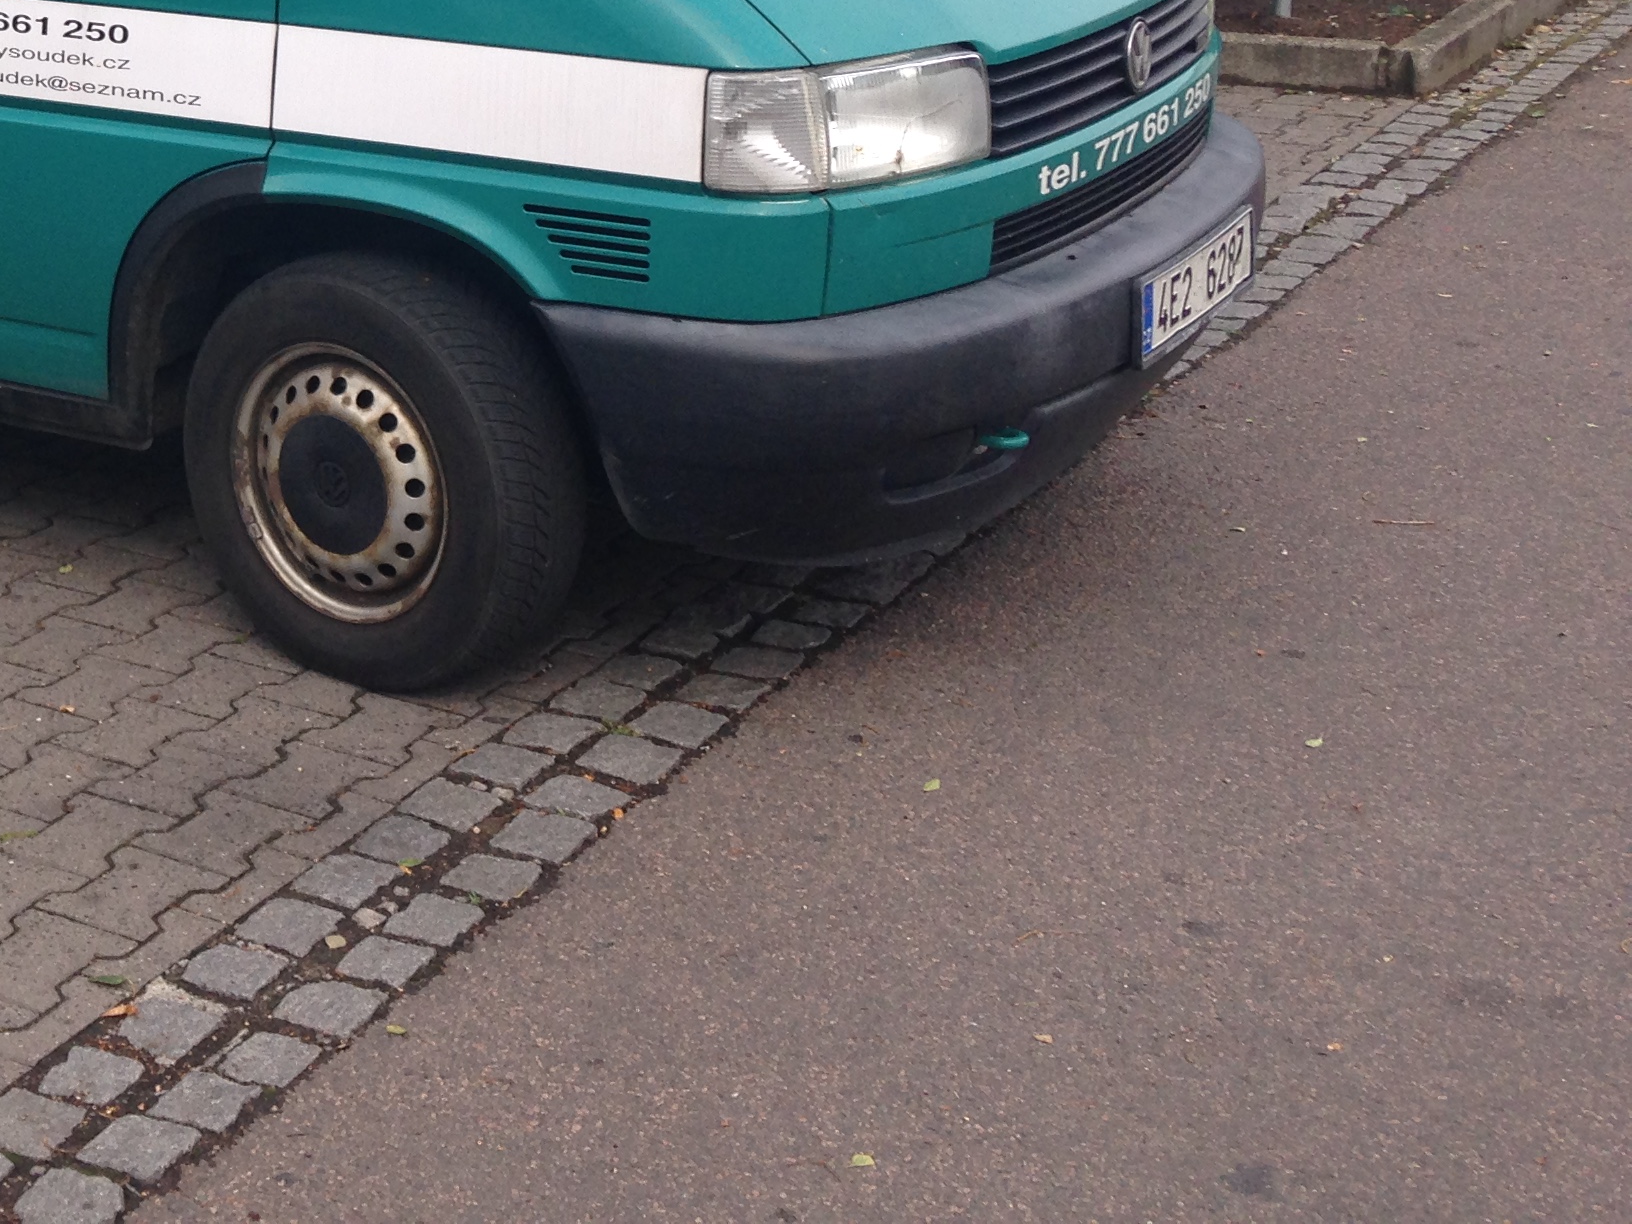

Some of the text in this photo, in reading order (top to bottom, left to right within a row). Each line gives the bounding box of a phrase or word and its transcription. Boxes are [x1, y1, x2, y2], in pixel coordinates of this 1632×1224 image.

[62, 19, 129, 44] 250
[1039, 73, 1211, 195] tel. 777 661 250
[1157, 266, 1192, 332] 4E2
